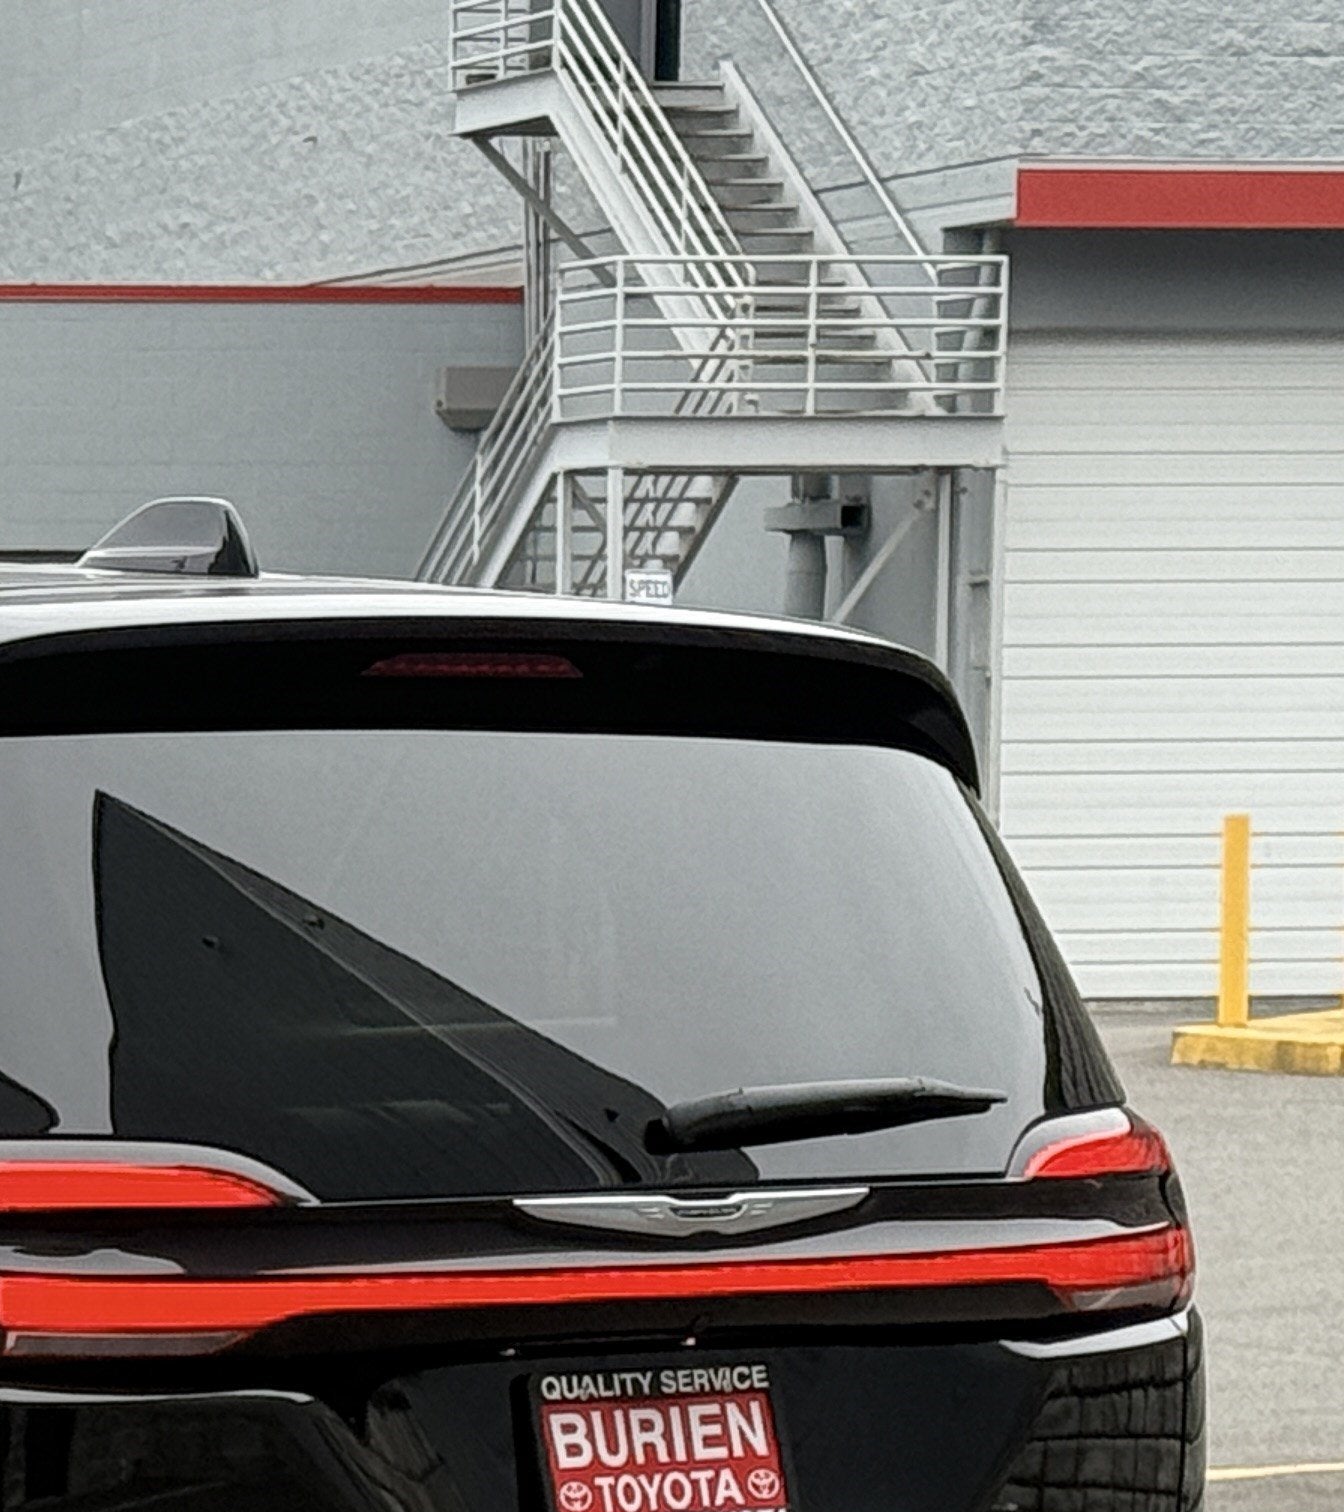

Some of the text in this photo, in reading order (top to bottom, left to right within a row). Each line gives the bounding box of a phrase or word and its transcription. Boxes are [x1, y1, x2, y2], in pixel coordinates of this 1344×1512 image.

[628, 578, 669, 599] SPEED
[541, 1365, 770, 1401] QUALITY SERVICE
[549, 1400, 769, 1471] BURIEN
